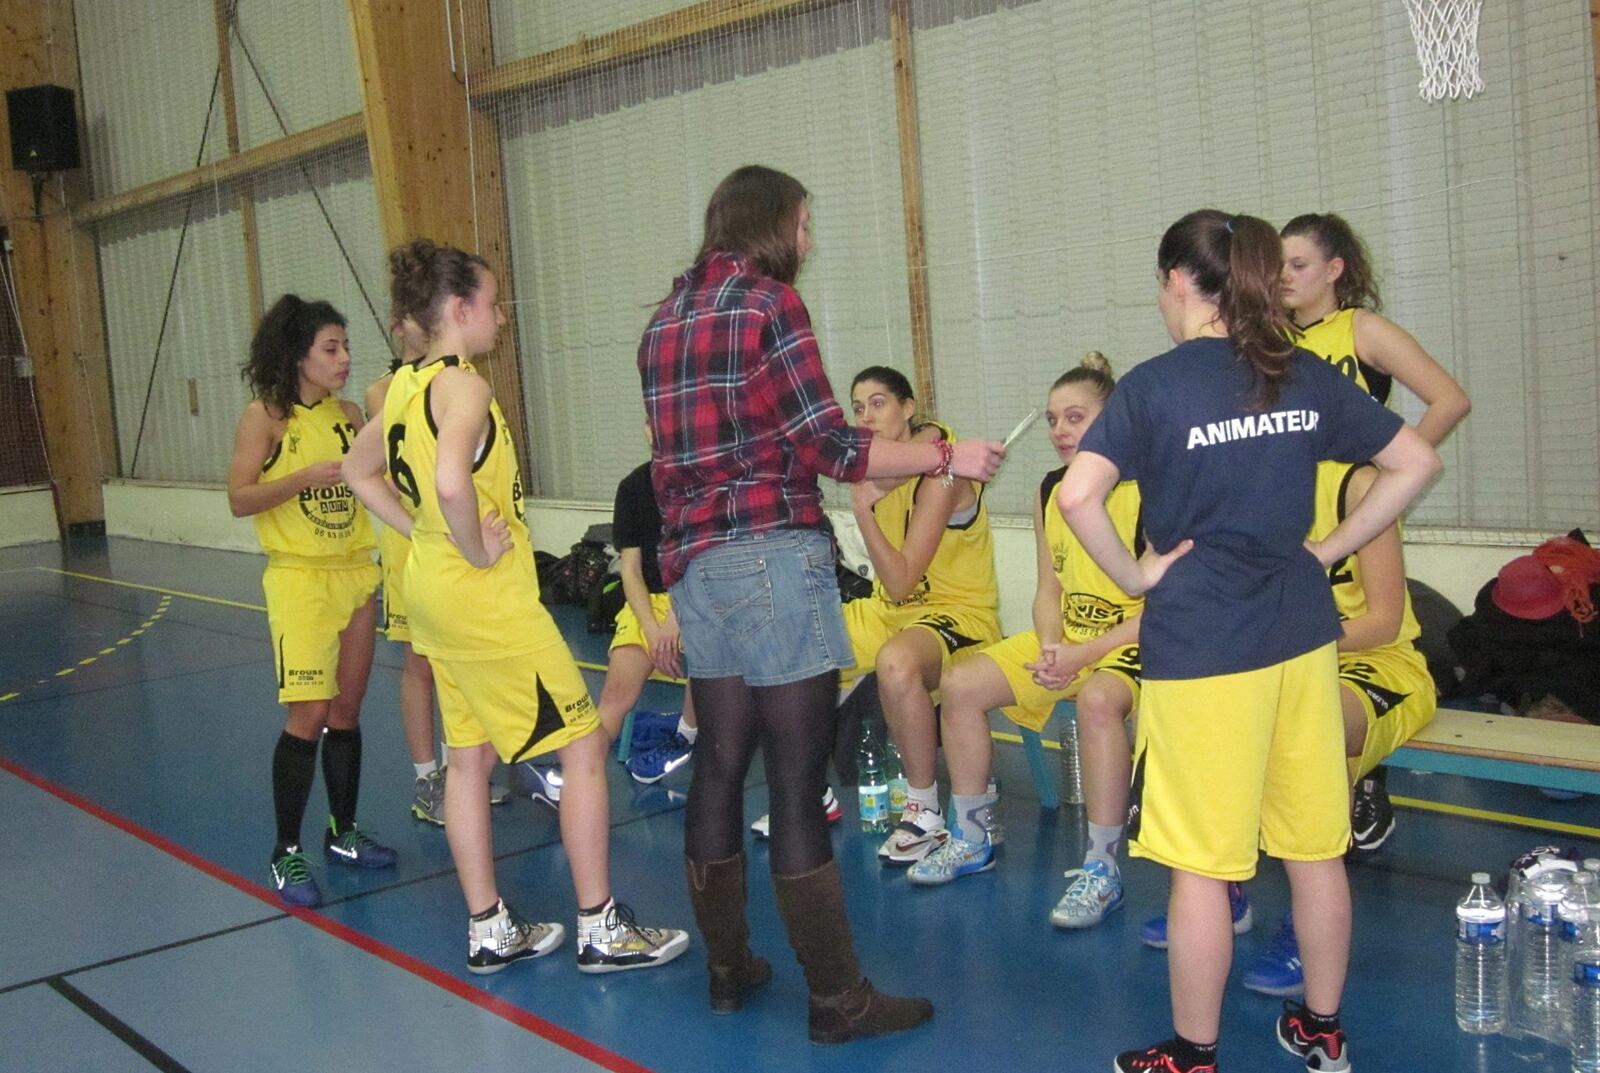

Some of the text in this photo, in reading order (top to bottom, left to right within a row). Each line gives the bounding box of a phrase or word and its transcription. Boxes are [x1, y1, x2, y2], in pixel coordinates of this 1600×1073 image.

[1326, 354, 1357, 384] 0
[388, 423, 421, 508] 6
[299, 483, 353, 502] Brous
